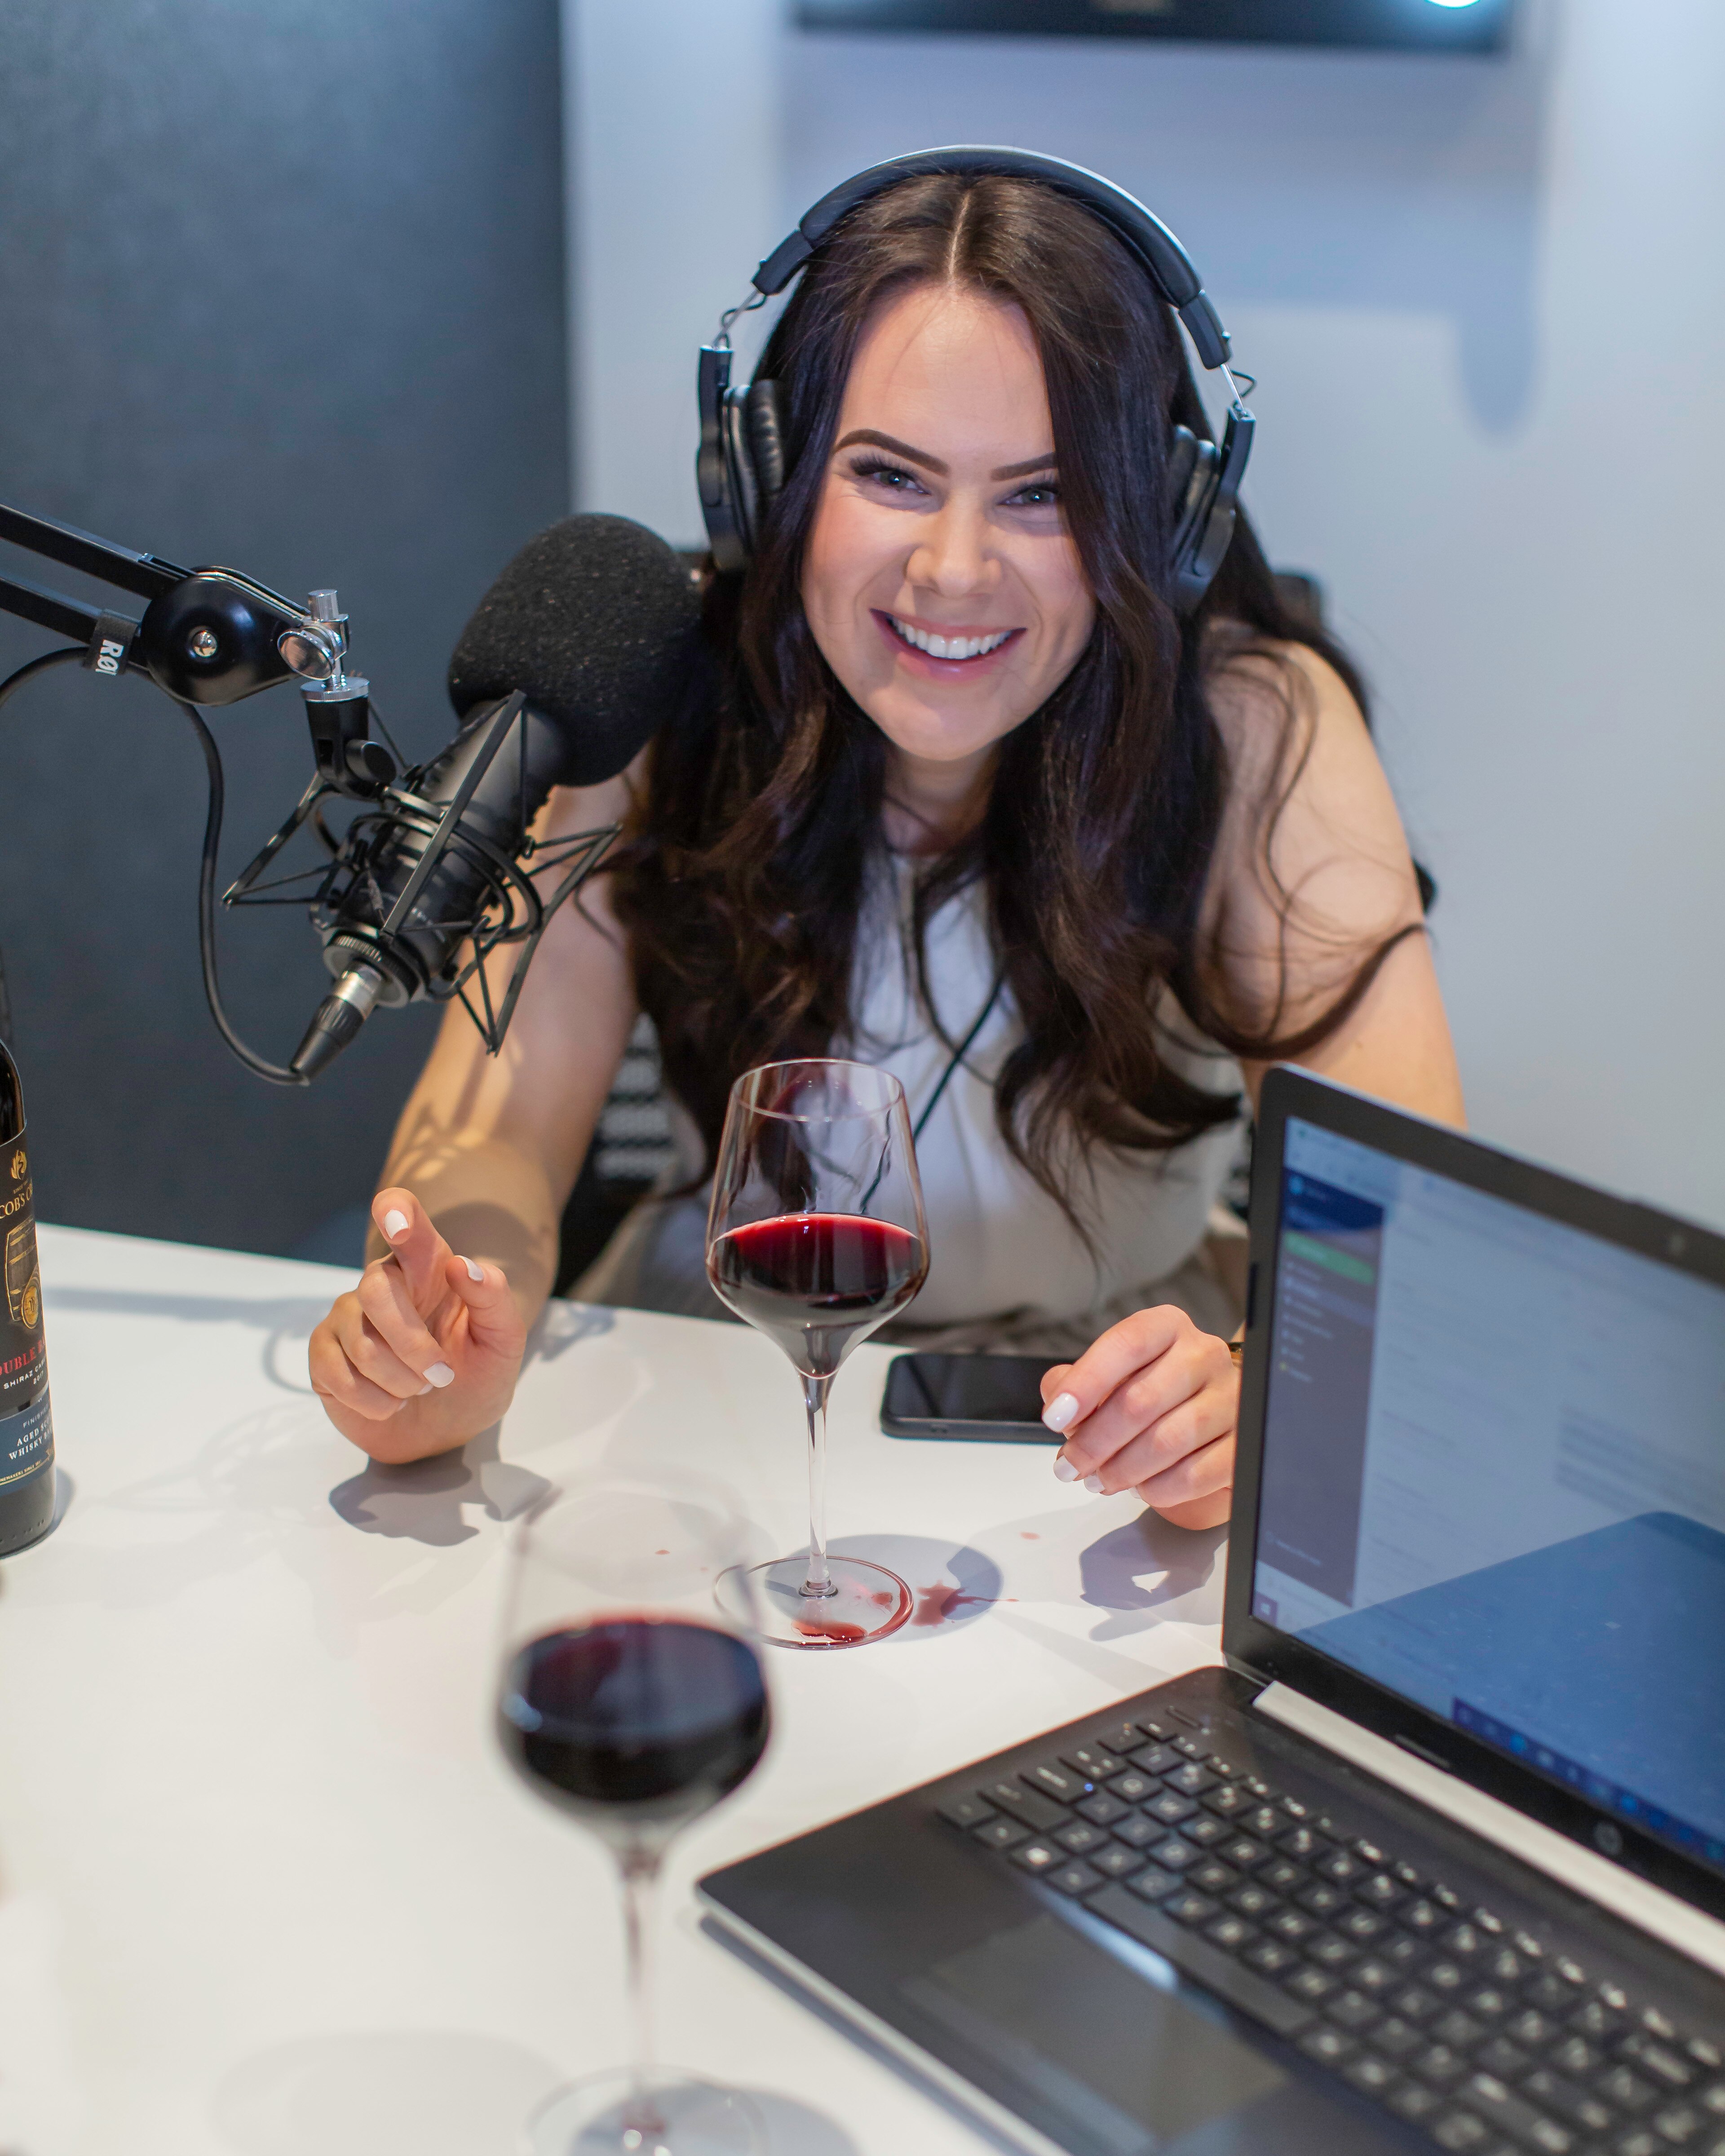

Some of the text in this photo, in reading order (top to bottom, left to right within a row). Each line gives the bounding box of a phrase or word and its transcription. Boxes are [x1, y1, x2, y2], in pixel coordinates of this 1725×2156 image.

[3, 1370, 33, 1389] SHIRAZ
[17, 1427, 40, 1447] AGED
[9, 1435, 42, 1460] WHISKY
